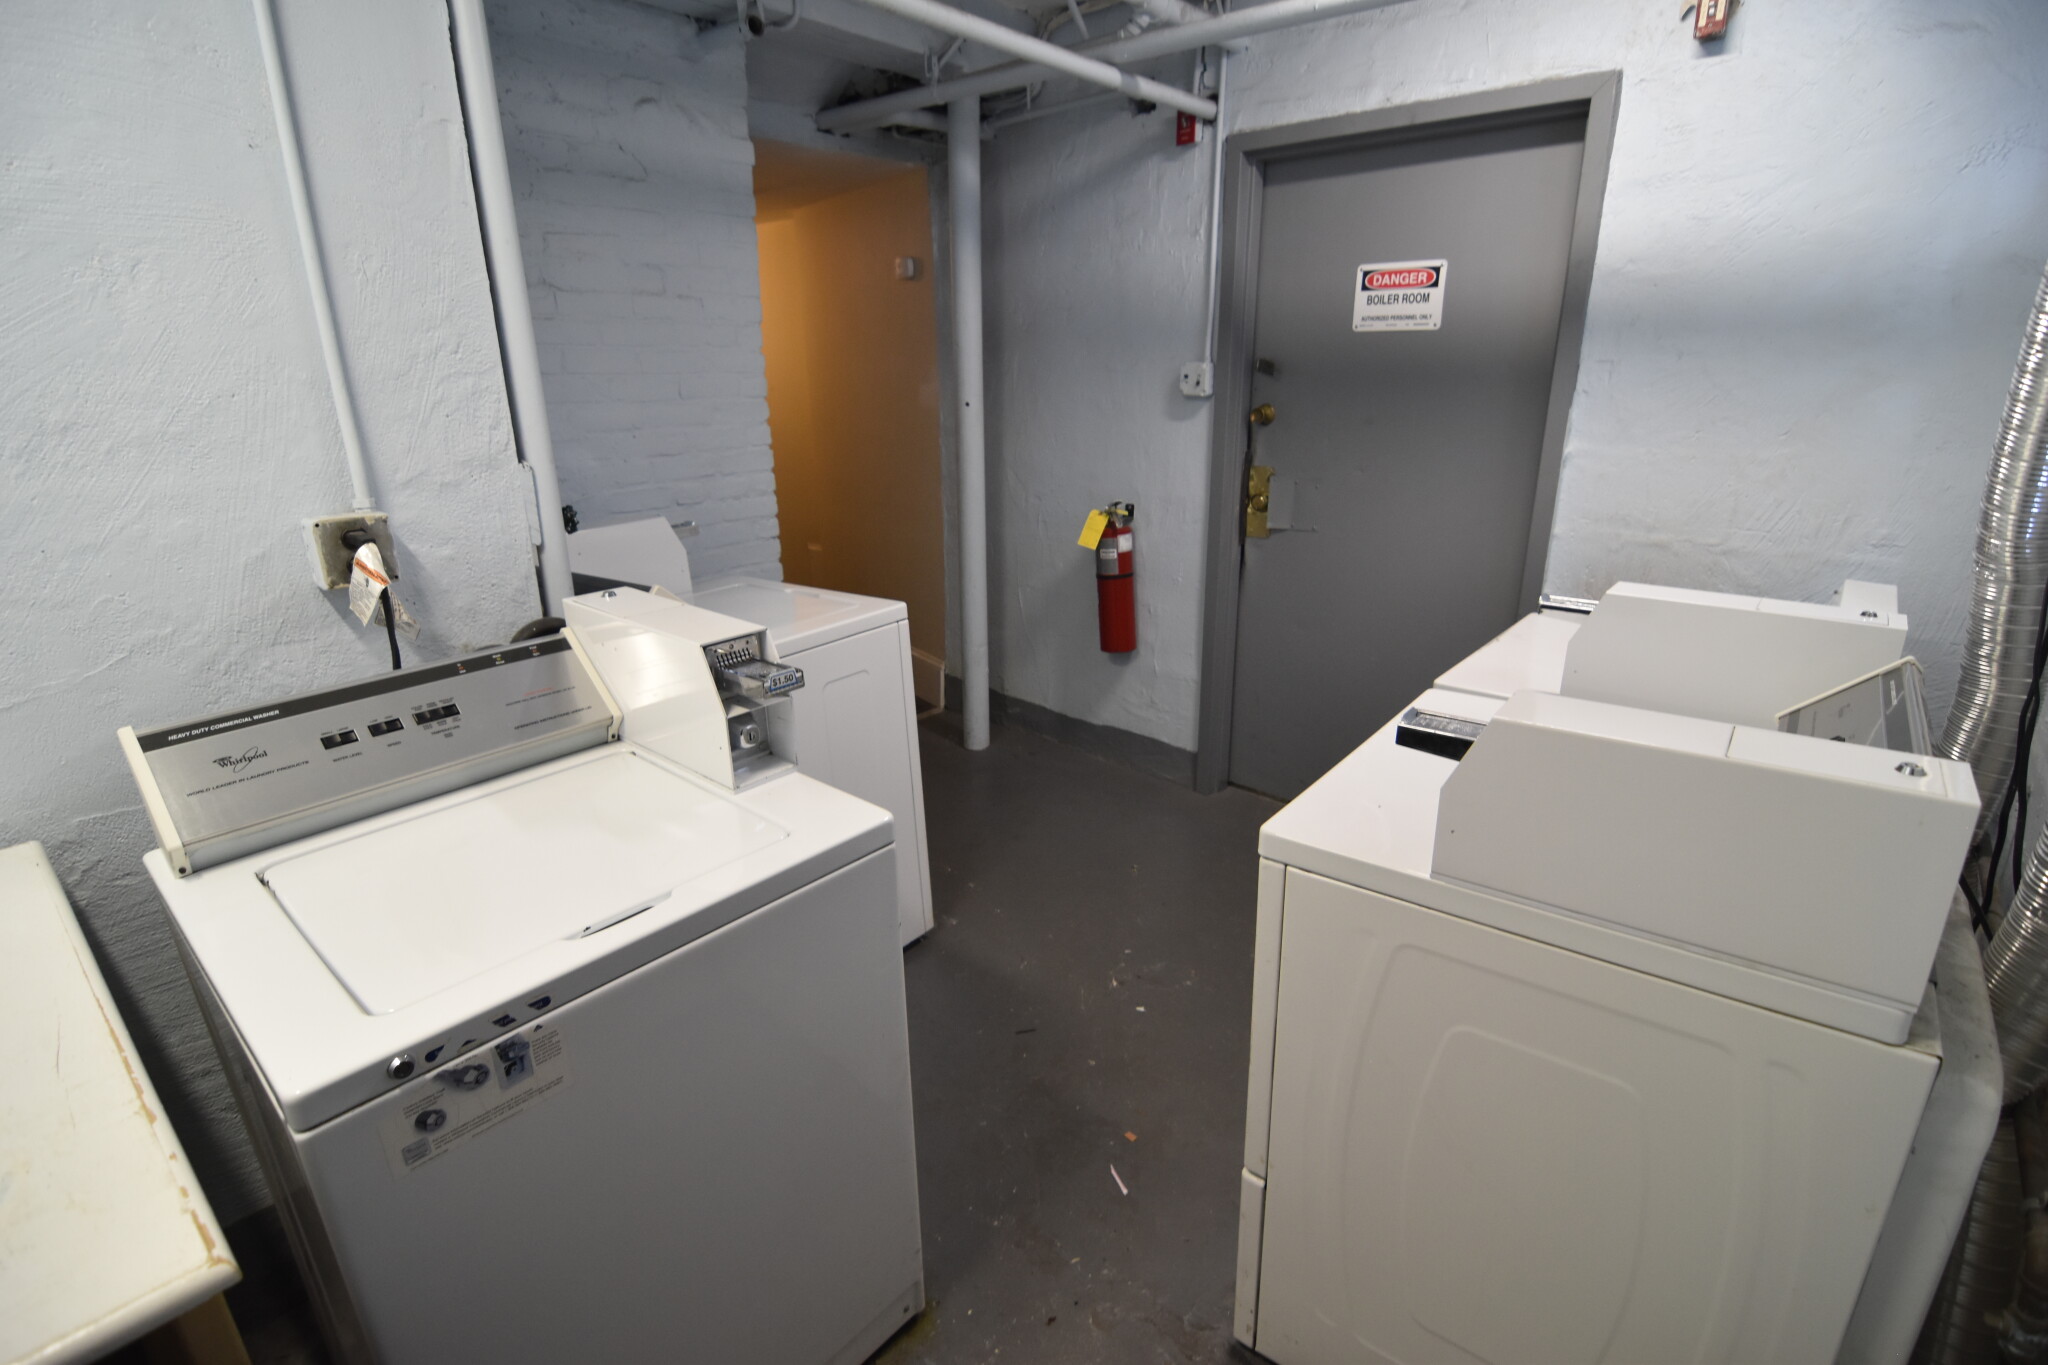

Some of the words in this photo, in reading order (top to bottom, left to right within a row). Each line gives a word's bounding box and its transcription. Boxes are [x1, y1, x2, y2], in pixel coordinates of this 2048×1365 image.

[1373, 272, 1427, 286] DANGER
[1366, 293, 1399, 306] BOILER
[1402, 292, 1430, 304] ROOM
[772, 673, 794, 687] $1.50
[168, 731, 190, 741] HEAVY
[191, 726, 209, 735] DUTY
[210, 717, 252, 731] COMMERCIAL
[253, 710, 280, 720] WASHER
[213, 748, 268, 770] Whirlpool
[186, 788, 211, 797] WORLD
[212, 780, 237, 790] LEADER
[246, 770, 275, 781] LAUNDRY
[276, 760, 309, 772] PRODUCTS
